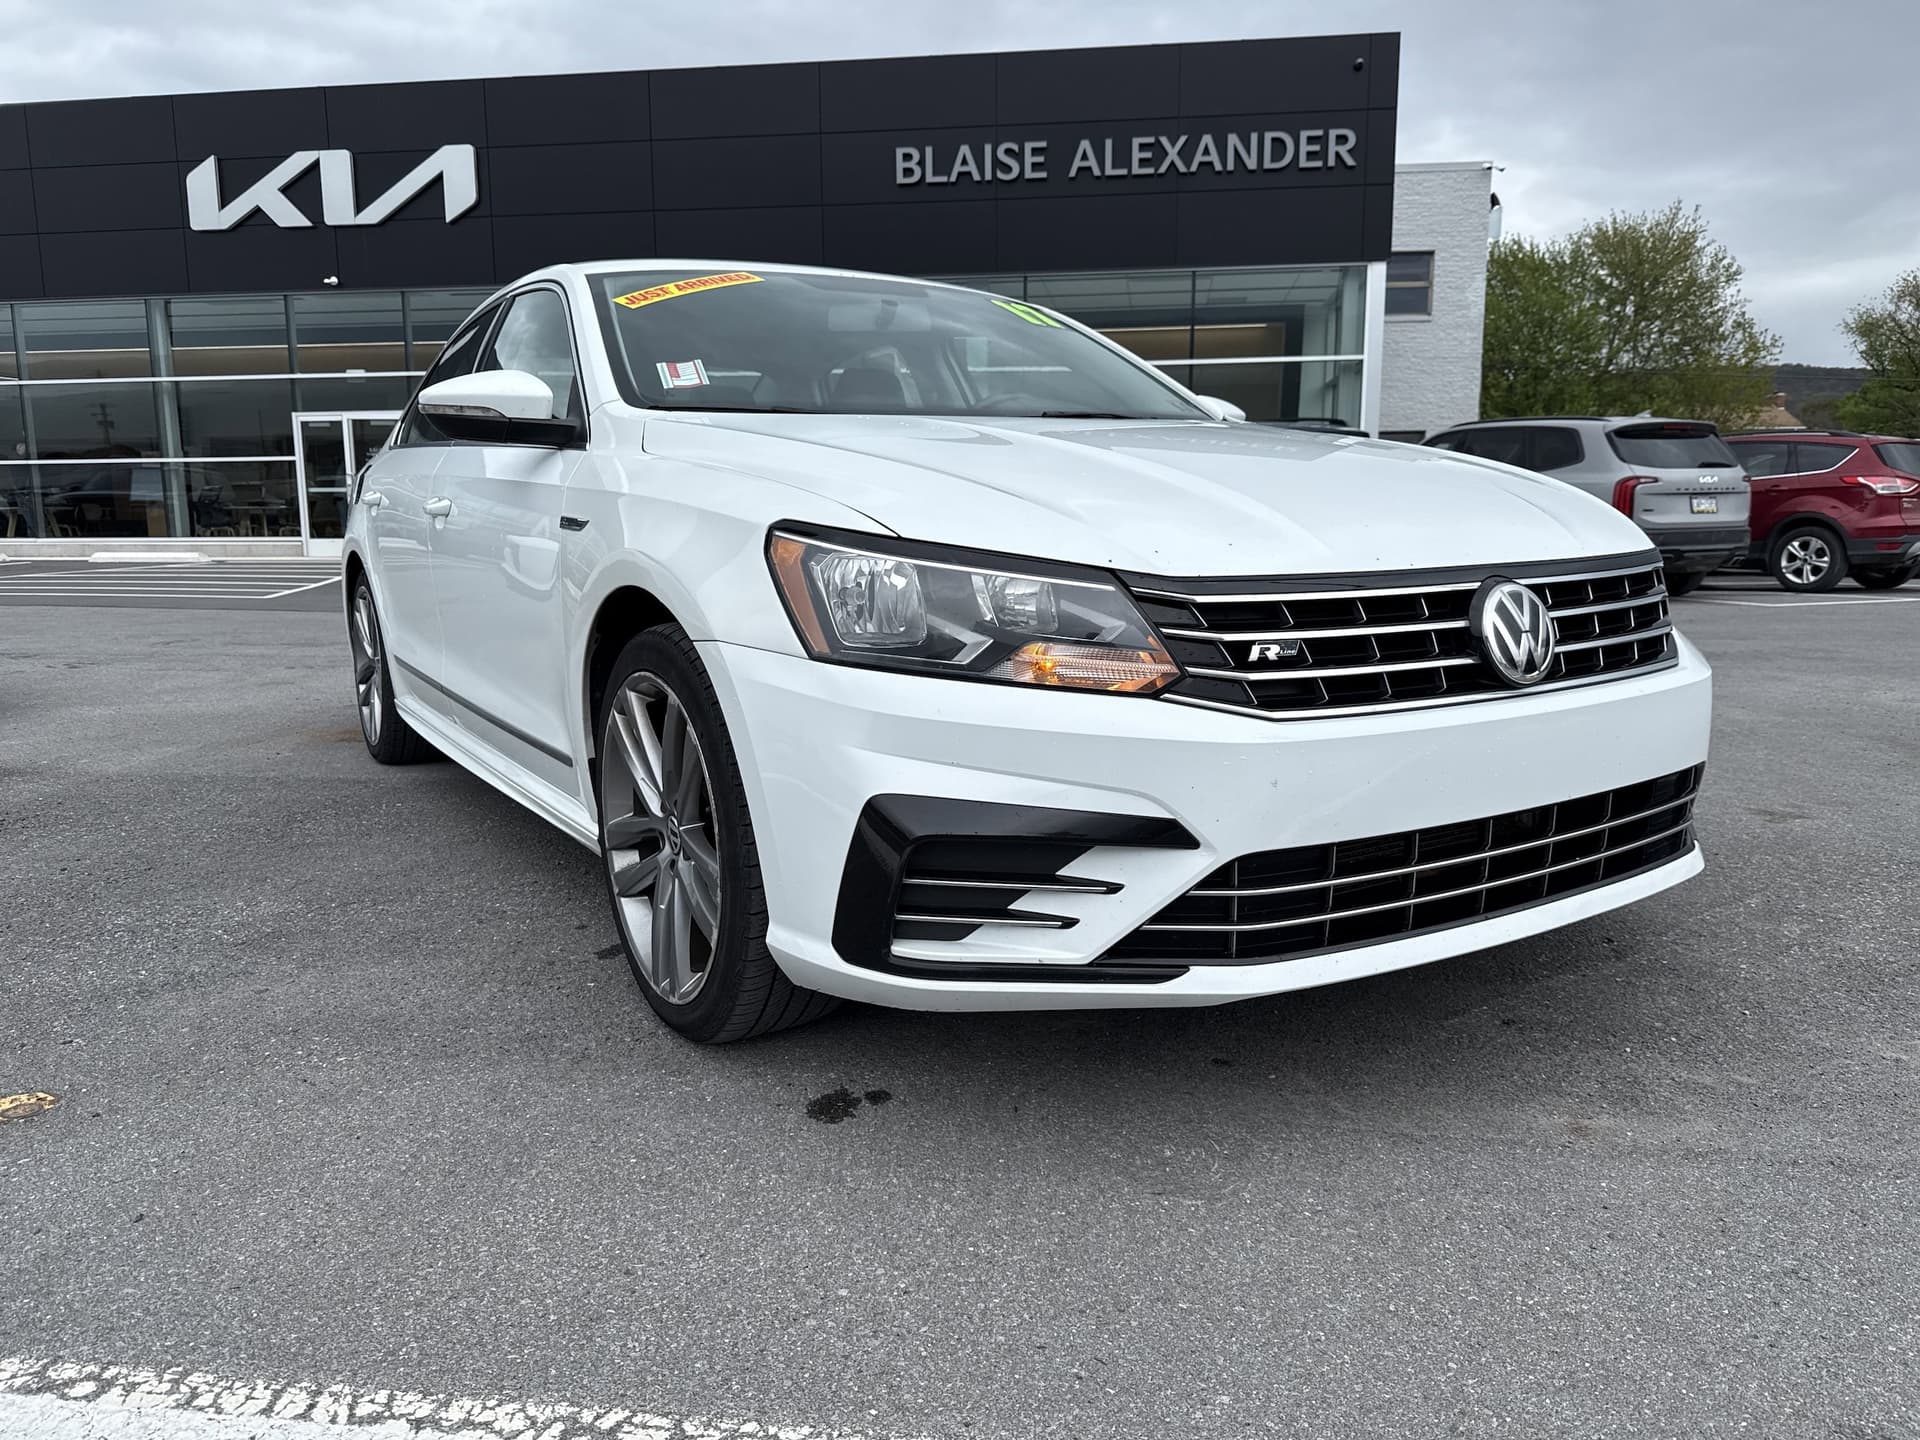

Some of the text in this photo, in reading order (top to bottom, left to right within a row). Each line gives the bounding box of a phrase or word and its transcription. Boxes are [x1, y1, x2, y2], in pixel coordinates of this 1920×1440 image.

[894, 128, 1357, 184] BLAISE ALEXANDER
[624, 273, 754, 305] JUST ARRIVED
